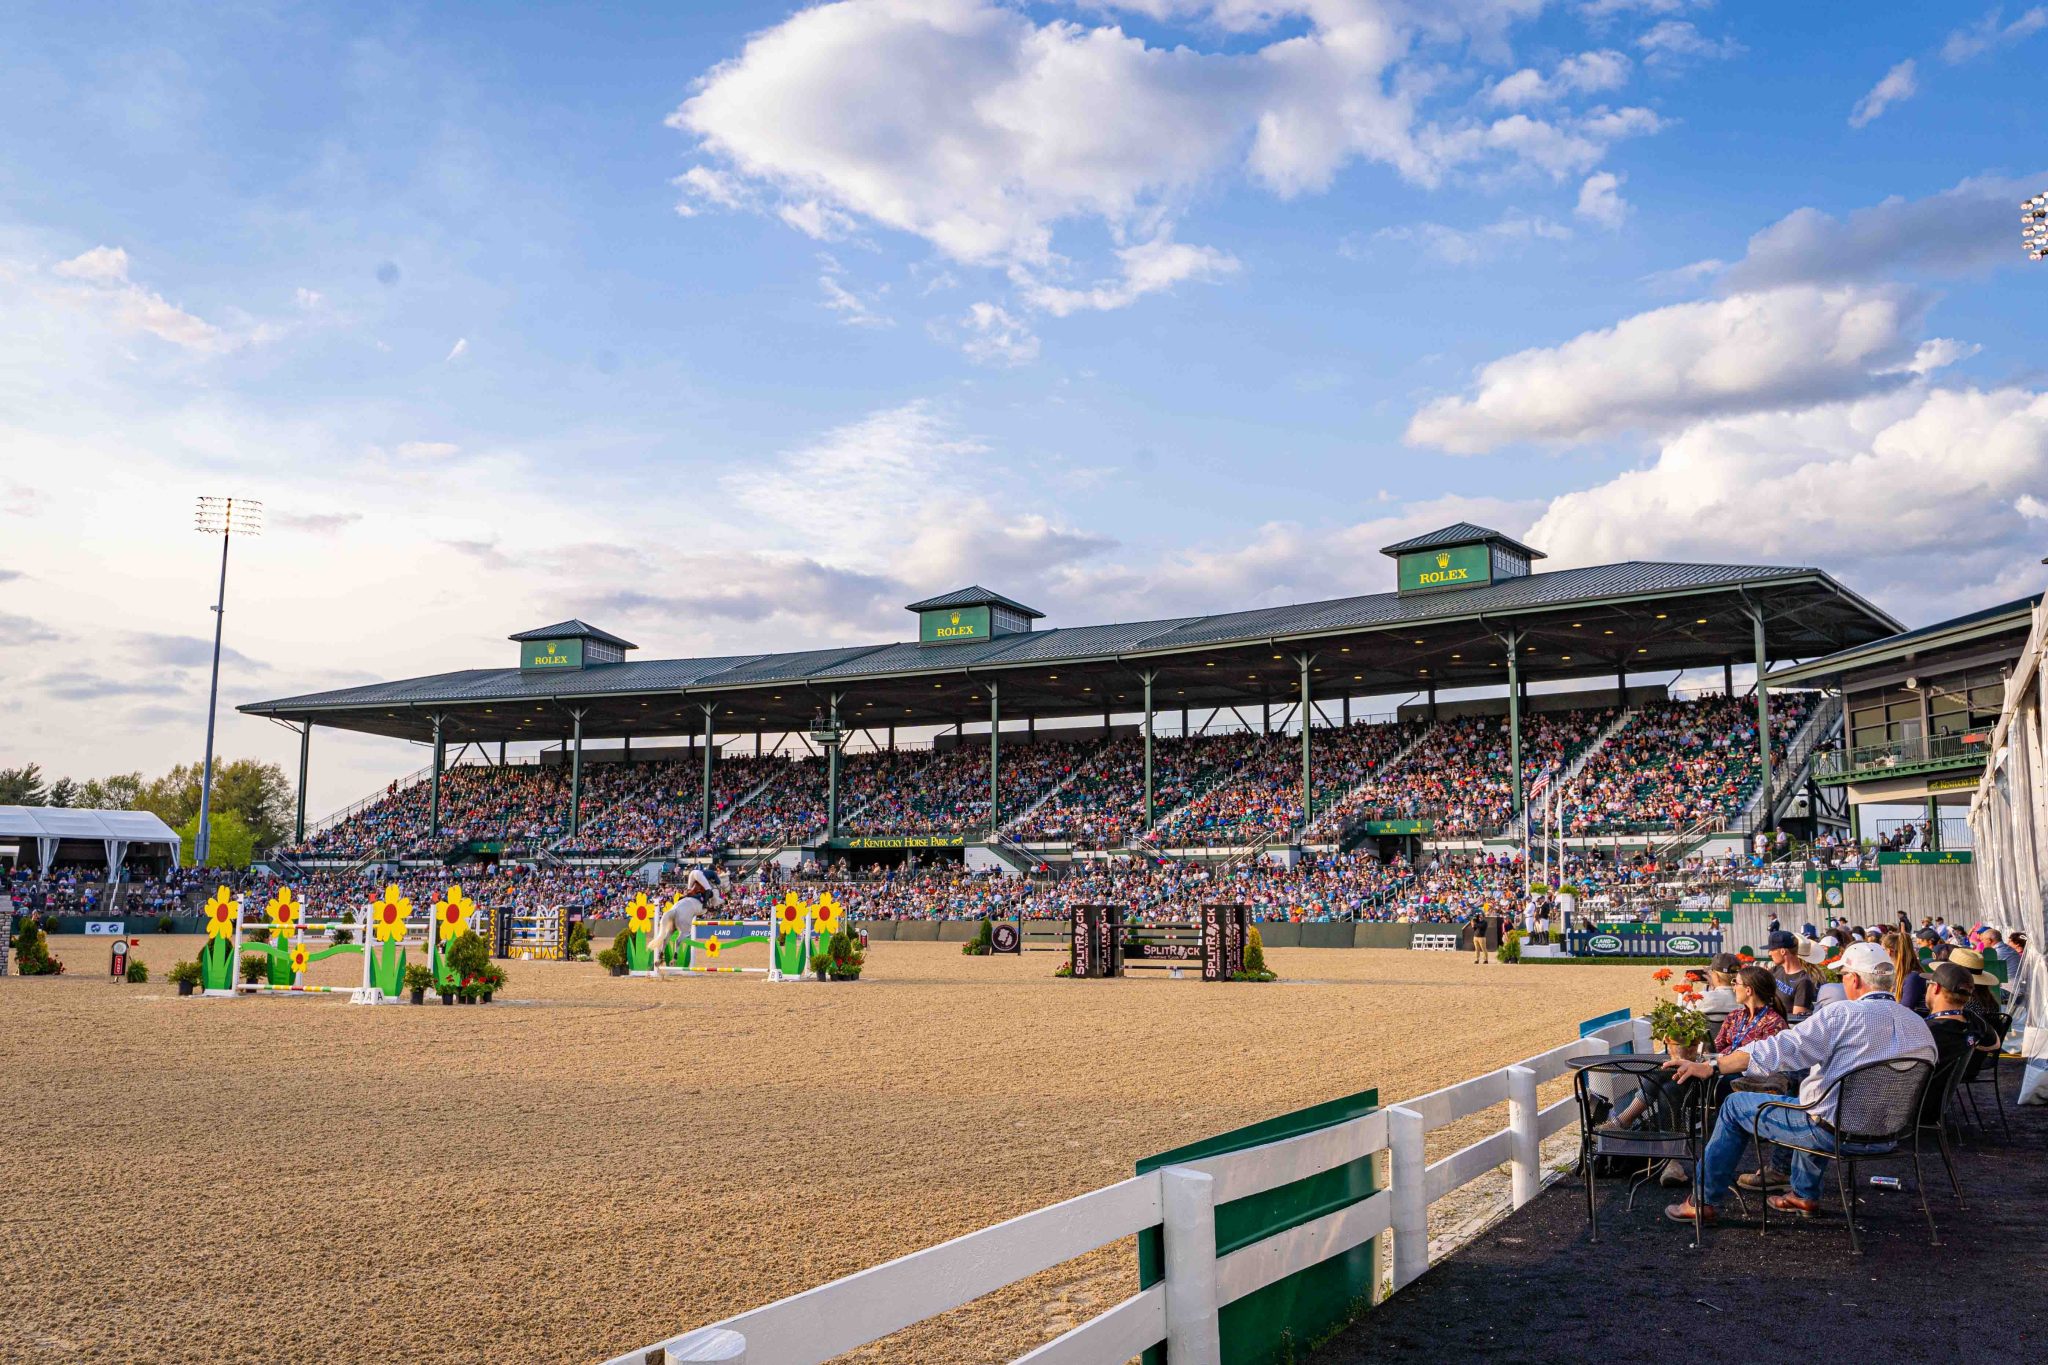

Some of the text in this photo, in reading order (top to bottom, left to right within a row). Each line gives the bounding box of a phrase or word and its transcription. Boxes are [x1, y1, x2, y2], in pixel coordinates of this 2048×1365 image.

[1419, 568, 1468, 584] ROLEX
[937, 625, 974, 637] ROLEX
[535, 655, 568, 665] ROLEX
[863, 836, 949, 848] KENTUCKY HORSE PARK
[377, 991, 384, 1001] A
